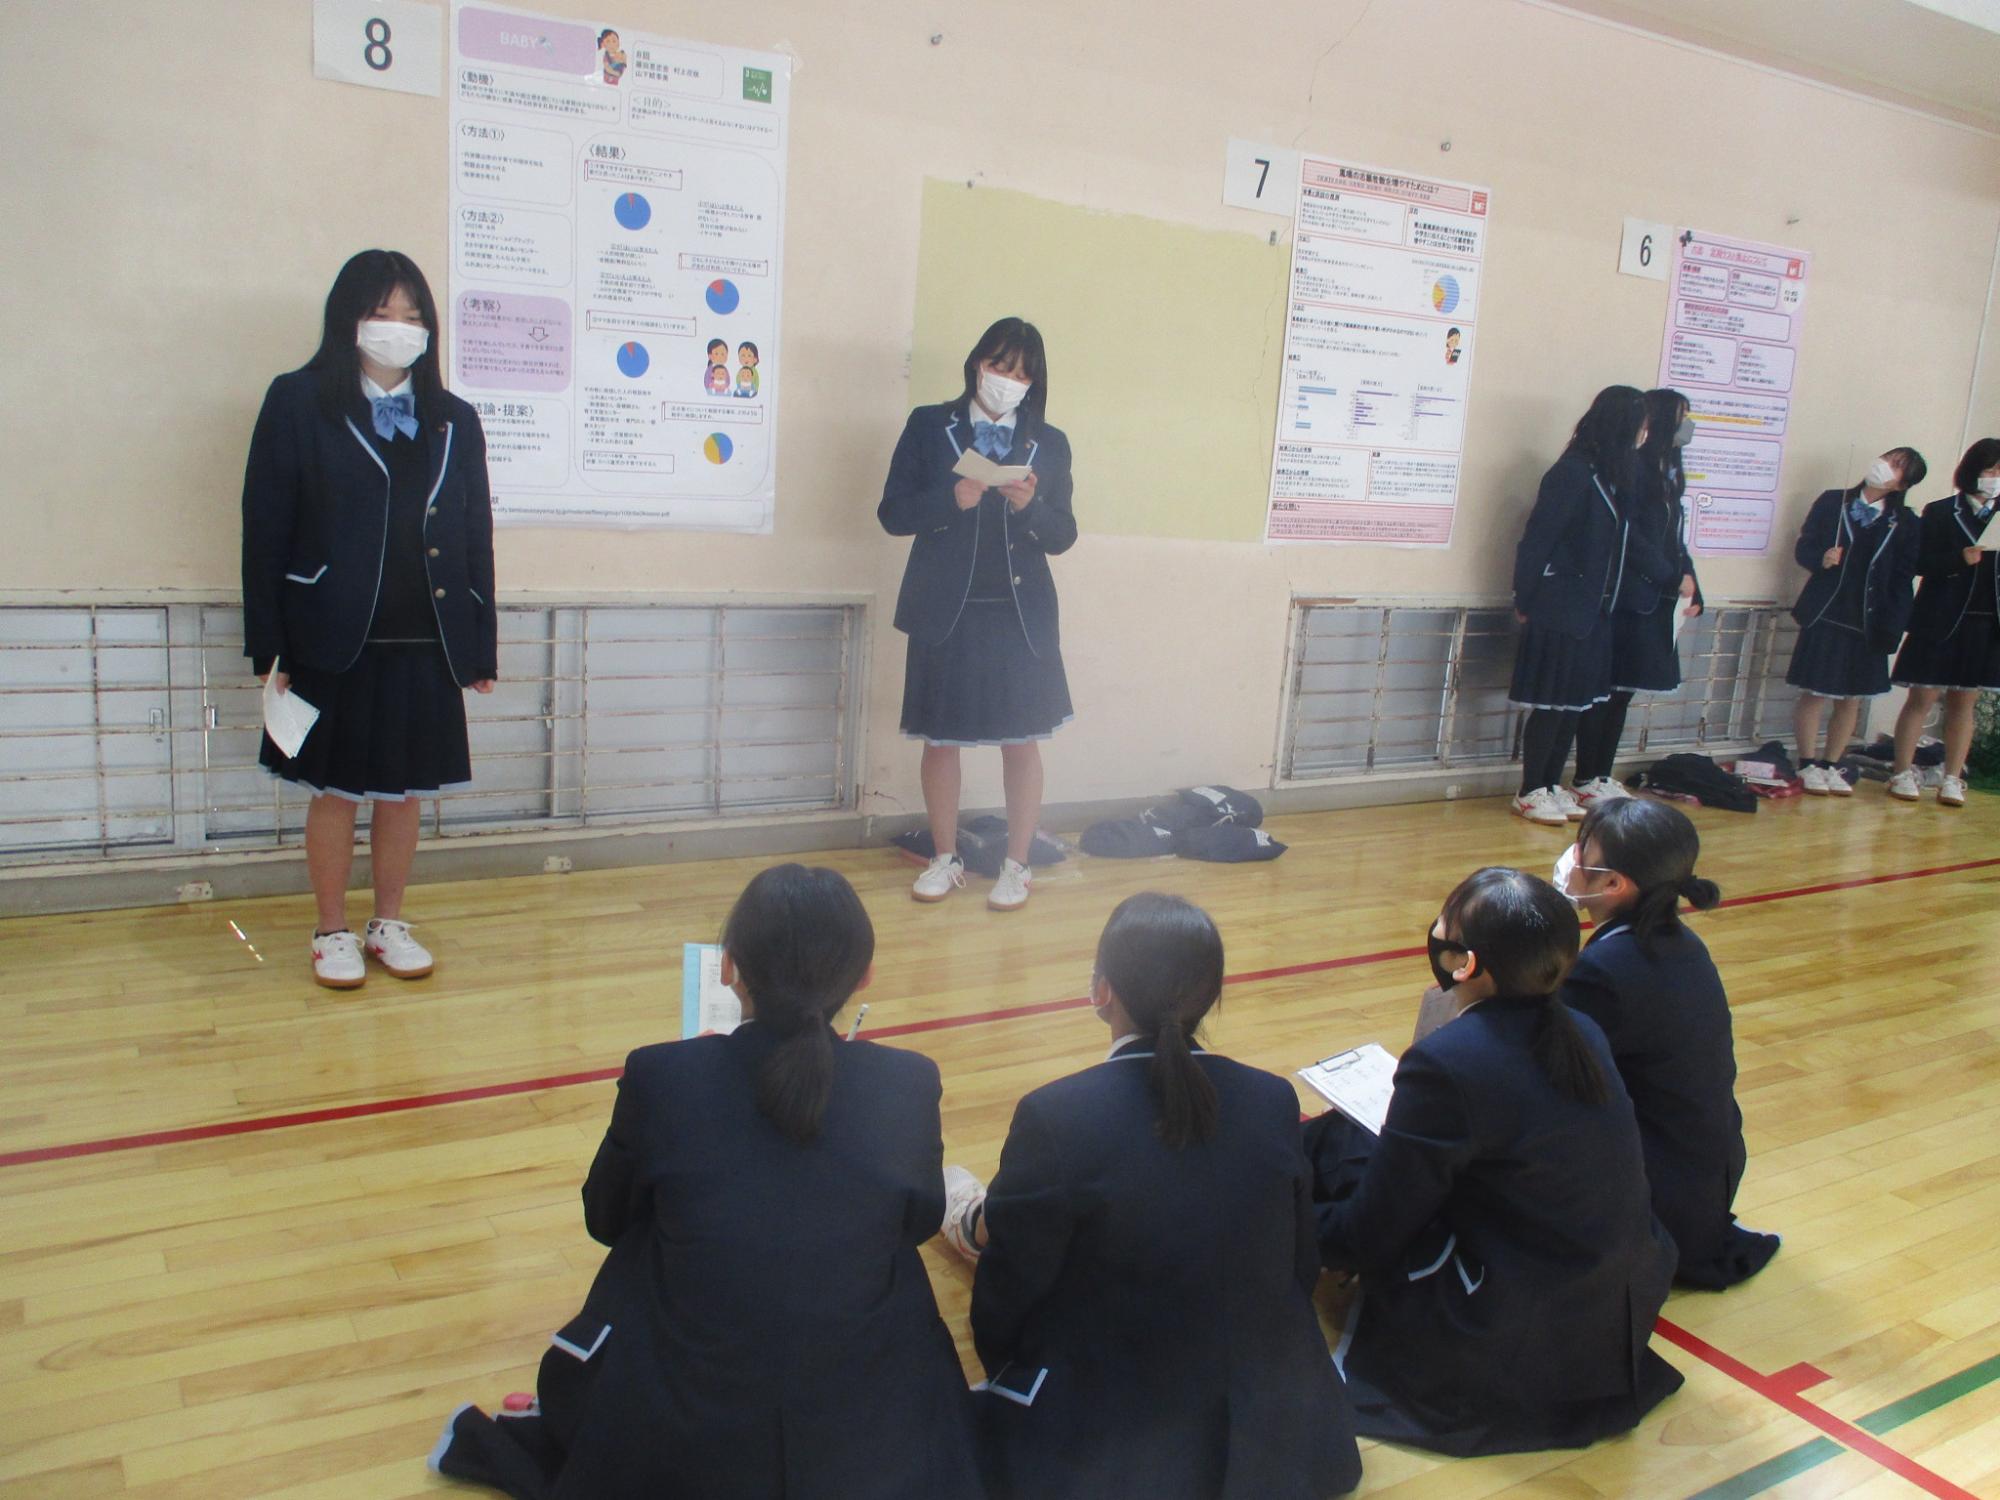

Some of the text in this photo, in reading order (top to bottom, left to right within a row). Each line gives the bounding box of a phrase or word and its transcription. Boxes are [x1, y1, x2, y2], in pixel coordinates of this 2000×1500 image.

[365, 18, 392, 70] 8
[500, 31, 538, 49] BABY
[1254, 158, 1270, 199] 7
[1640, 234, 1652, 267] 6
